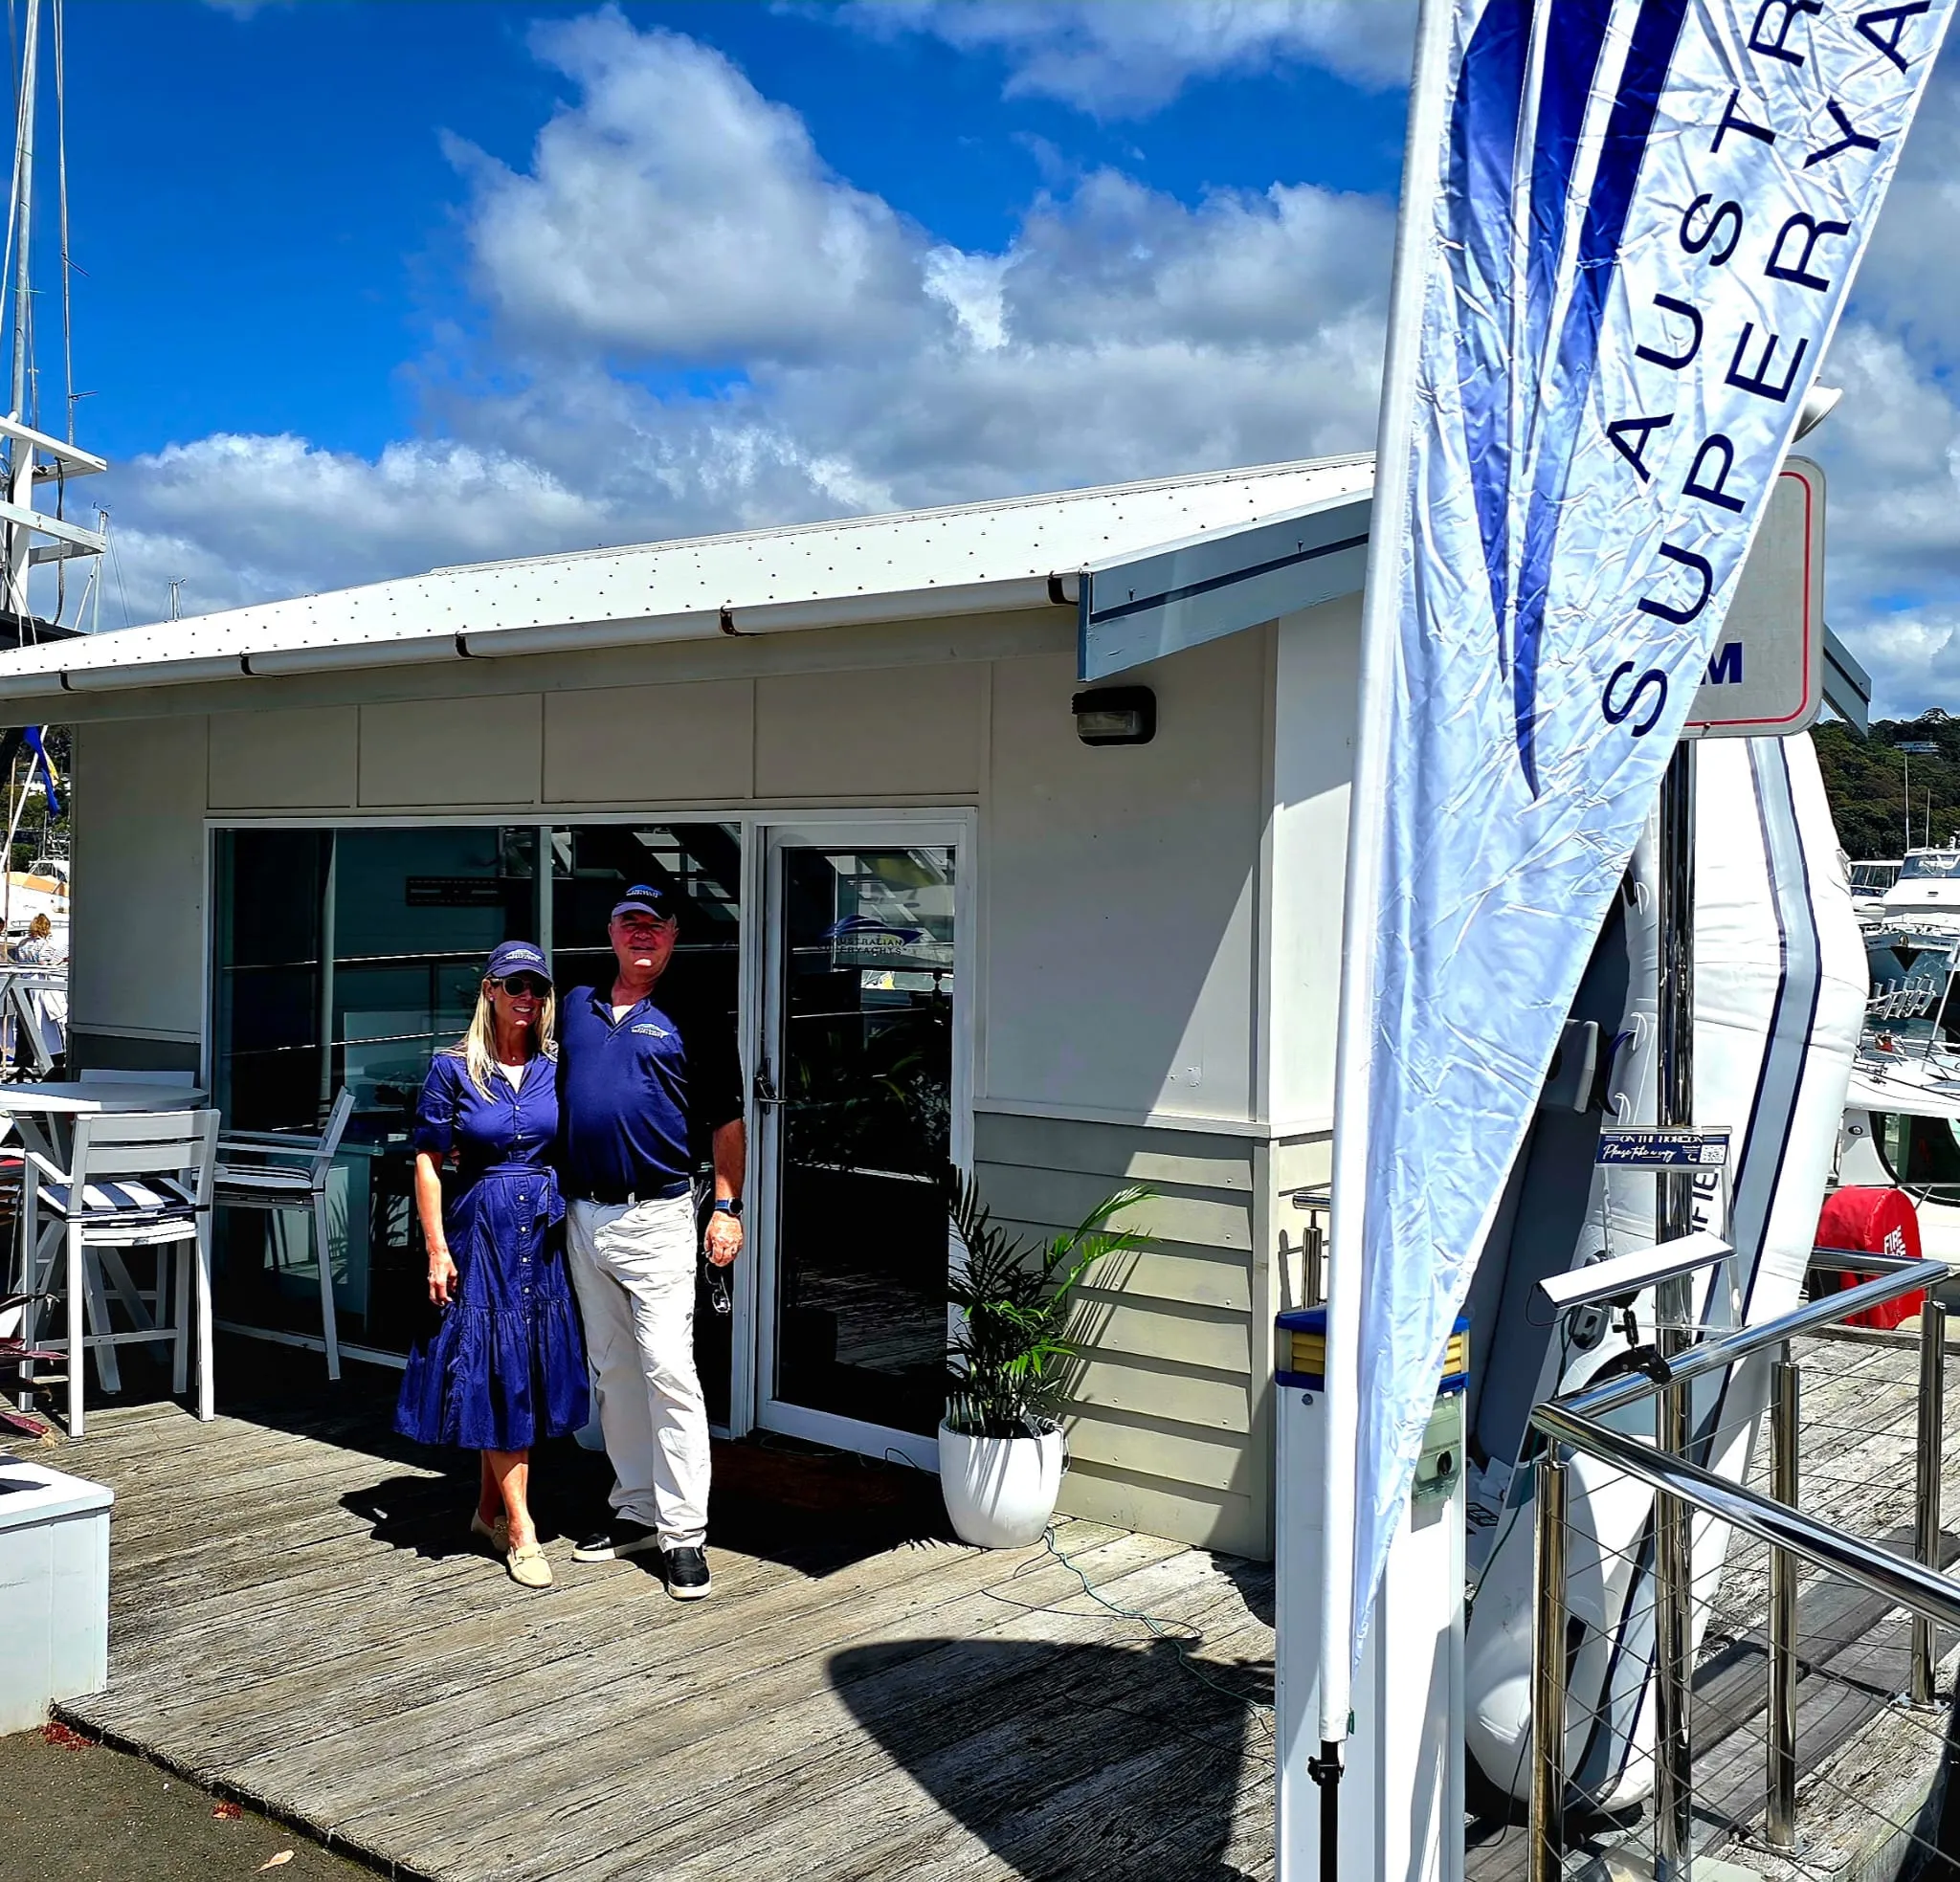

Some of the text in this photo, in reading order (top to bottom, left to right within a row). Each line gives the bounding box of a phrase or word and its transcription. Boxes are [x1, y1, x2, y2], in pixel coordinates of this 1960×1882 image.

[1602, 0, 1931, 738] SUPERYA
[1606, 0, 1822, 482] AUSTR
[1602, 1143, 1631, 1160] Please
[1883, 1224, 1904, 1255] FIRE
